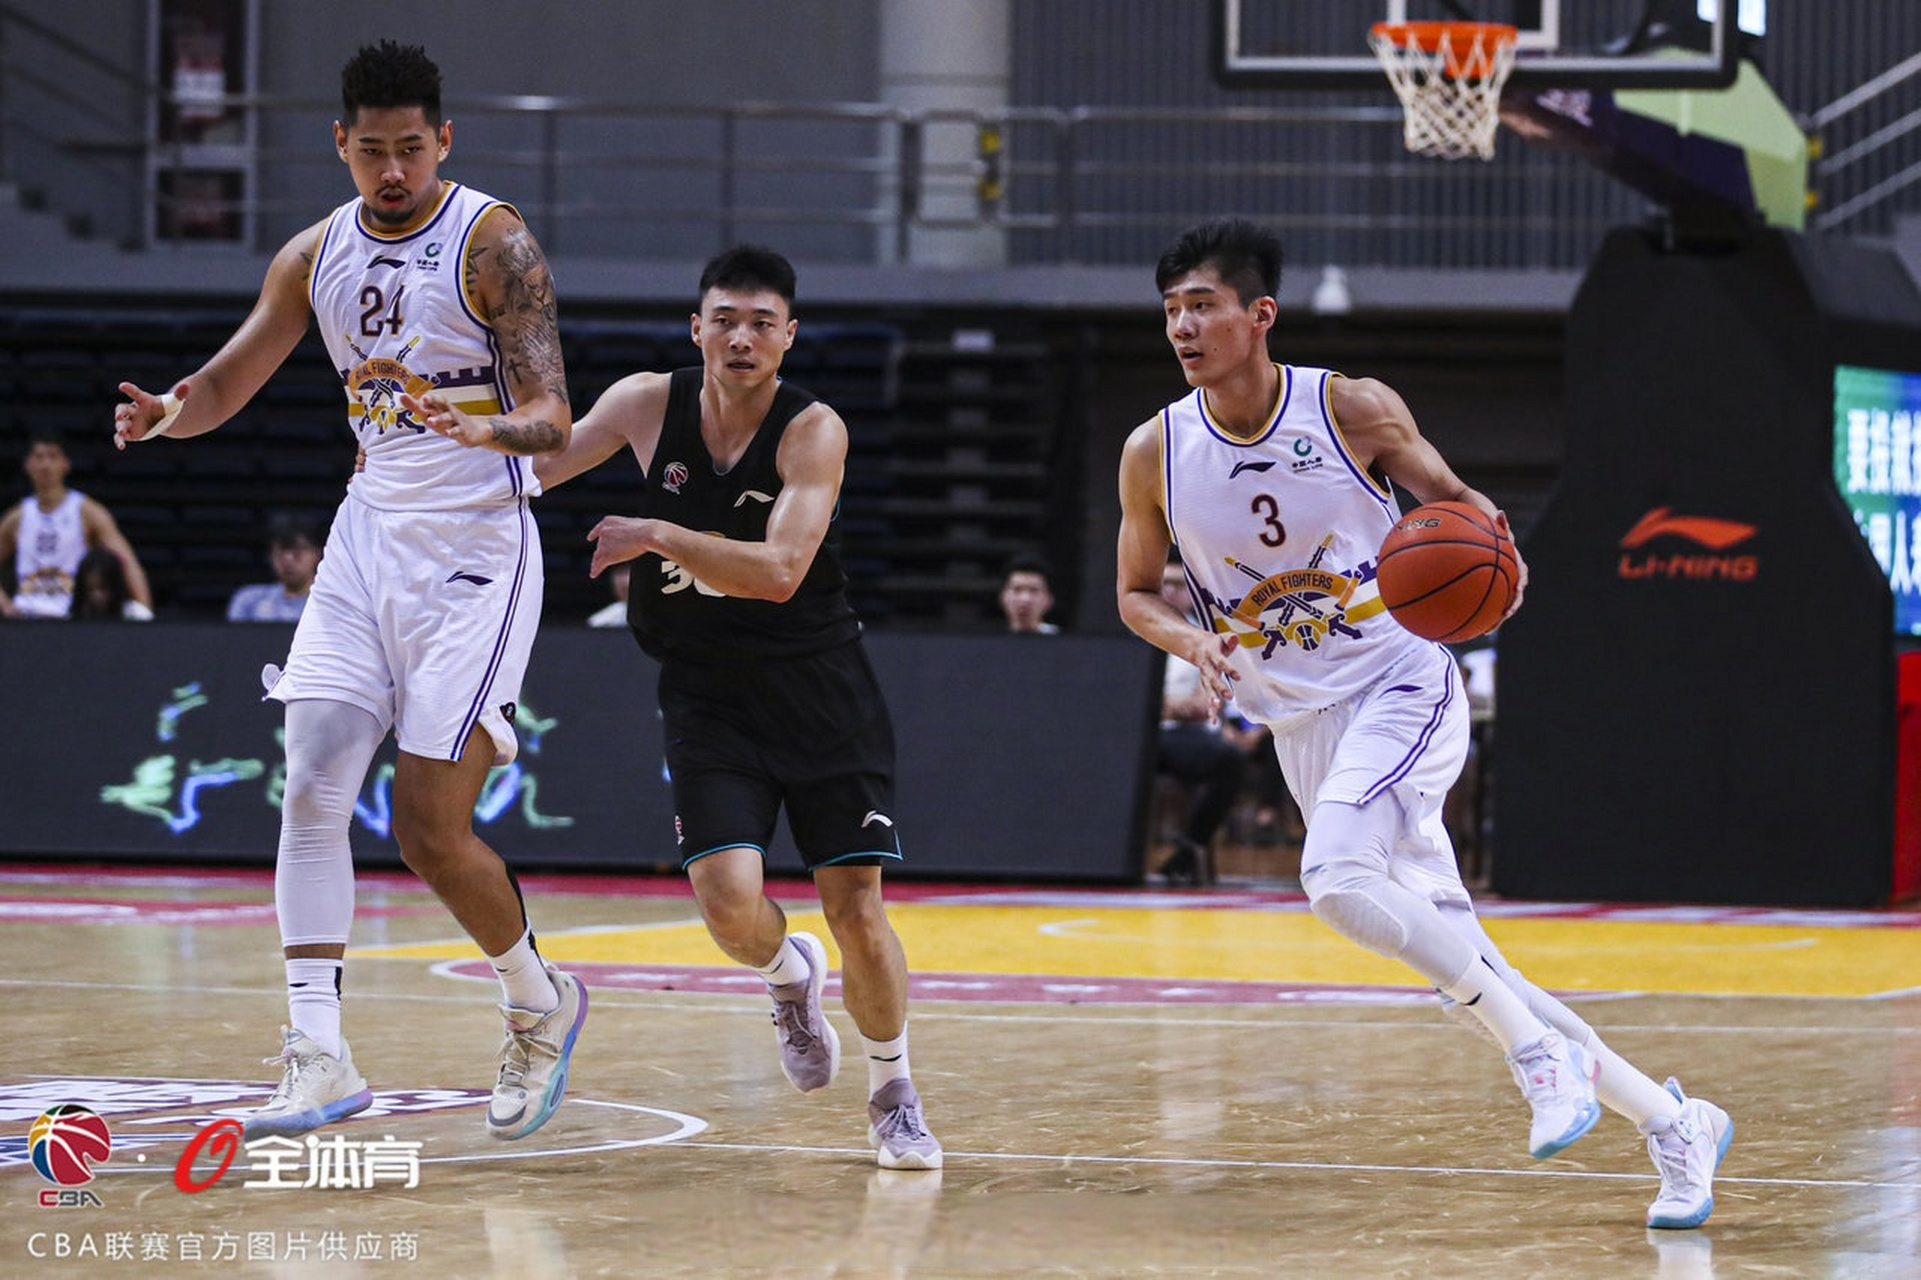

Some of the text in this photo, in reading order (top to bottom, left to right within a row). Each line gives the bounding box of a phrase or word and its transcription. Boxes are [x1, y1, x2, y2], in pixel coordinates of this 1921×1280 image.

[360, 285, 404, 337] 24
[1251, 494, 1286, 547] 3
[1618, 555, 1758, 579] LI-NING
[1251, 573, 1334, 606] ROYAL FIGHTERS
